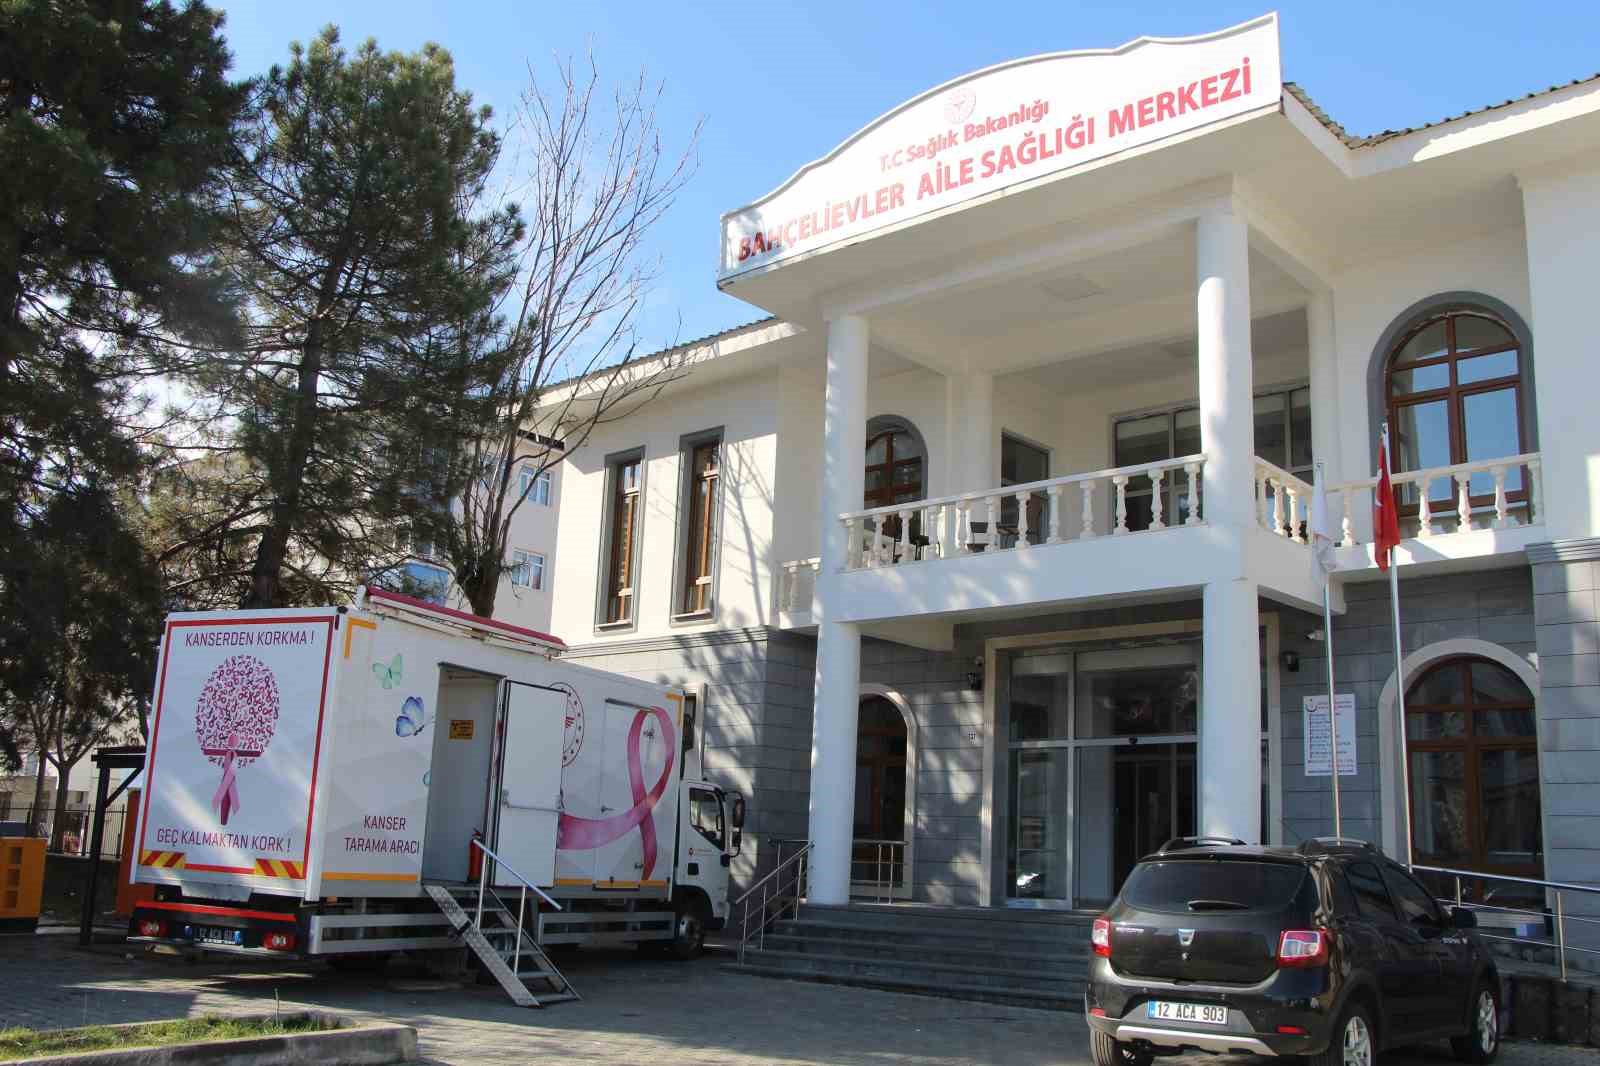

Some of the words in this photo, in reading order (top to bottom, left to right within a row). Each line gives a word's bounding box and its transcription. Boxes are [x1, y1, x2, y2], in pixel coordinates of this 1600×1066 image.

[906, 130, 959, 162] Sağlık
[963, 99, 1049, 142] Bakanlığı
[738, 182, 905, 261] BAHÇELİEVLER
[917, 157, 974, 200] AİLE
[981, 114, 1095, 179] SAĞLIĞI
[1108, 56, 1251, 137] MERKEZİ
[185, 631, 254, 647] KANSERDEN
[256, 630, 307, 646] KORKMA
[364, 815, 406, 831] KANSER
[157, 828, 179, 846] GEÇ
[181, 830, 249, 849] KALMAKTAN
[251, 834, 284, 853] KORK
[344, 837, 387, 853] TARAMA
[389, 840, 420, 855] ARACI
[1158, 1002, 1170, 1017] 12
[1176, 1004, 1196, 1019] ACA
[1202, 1006, 1225, 1022] 903
